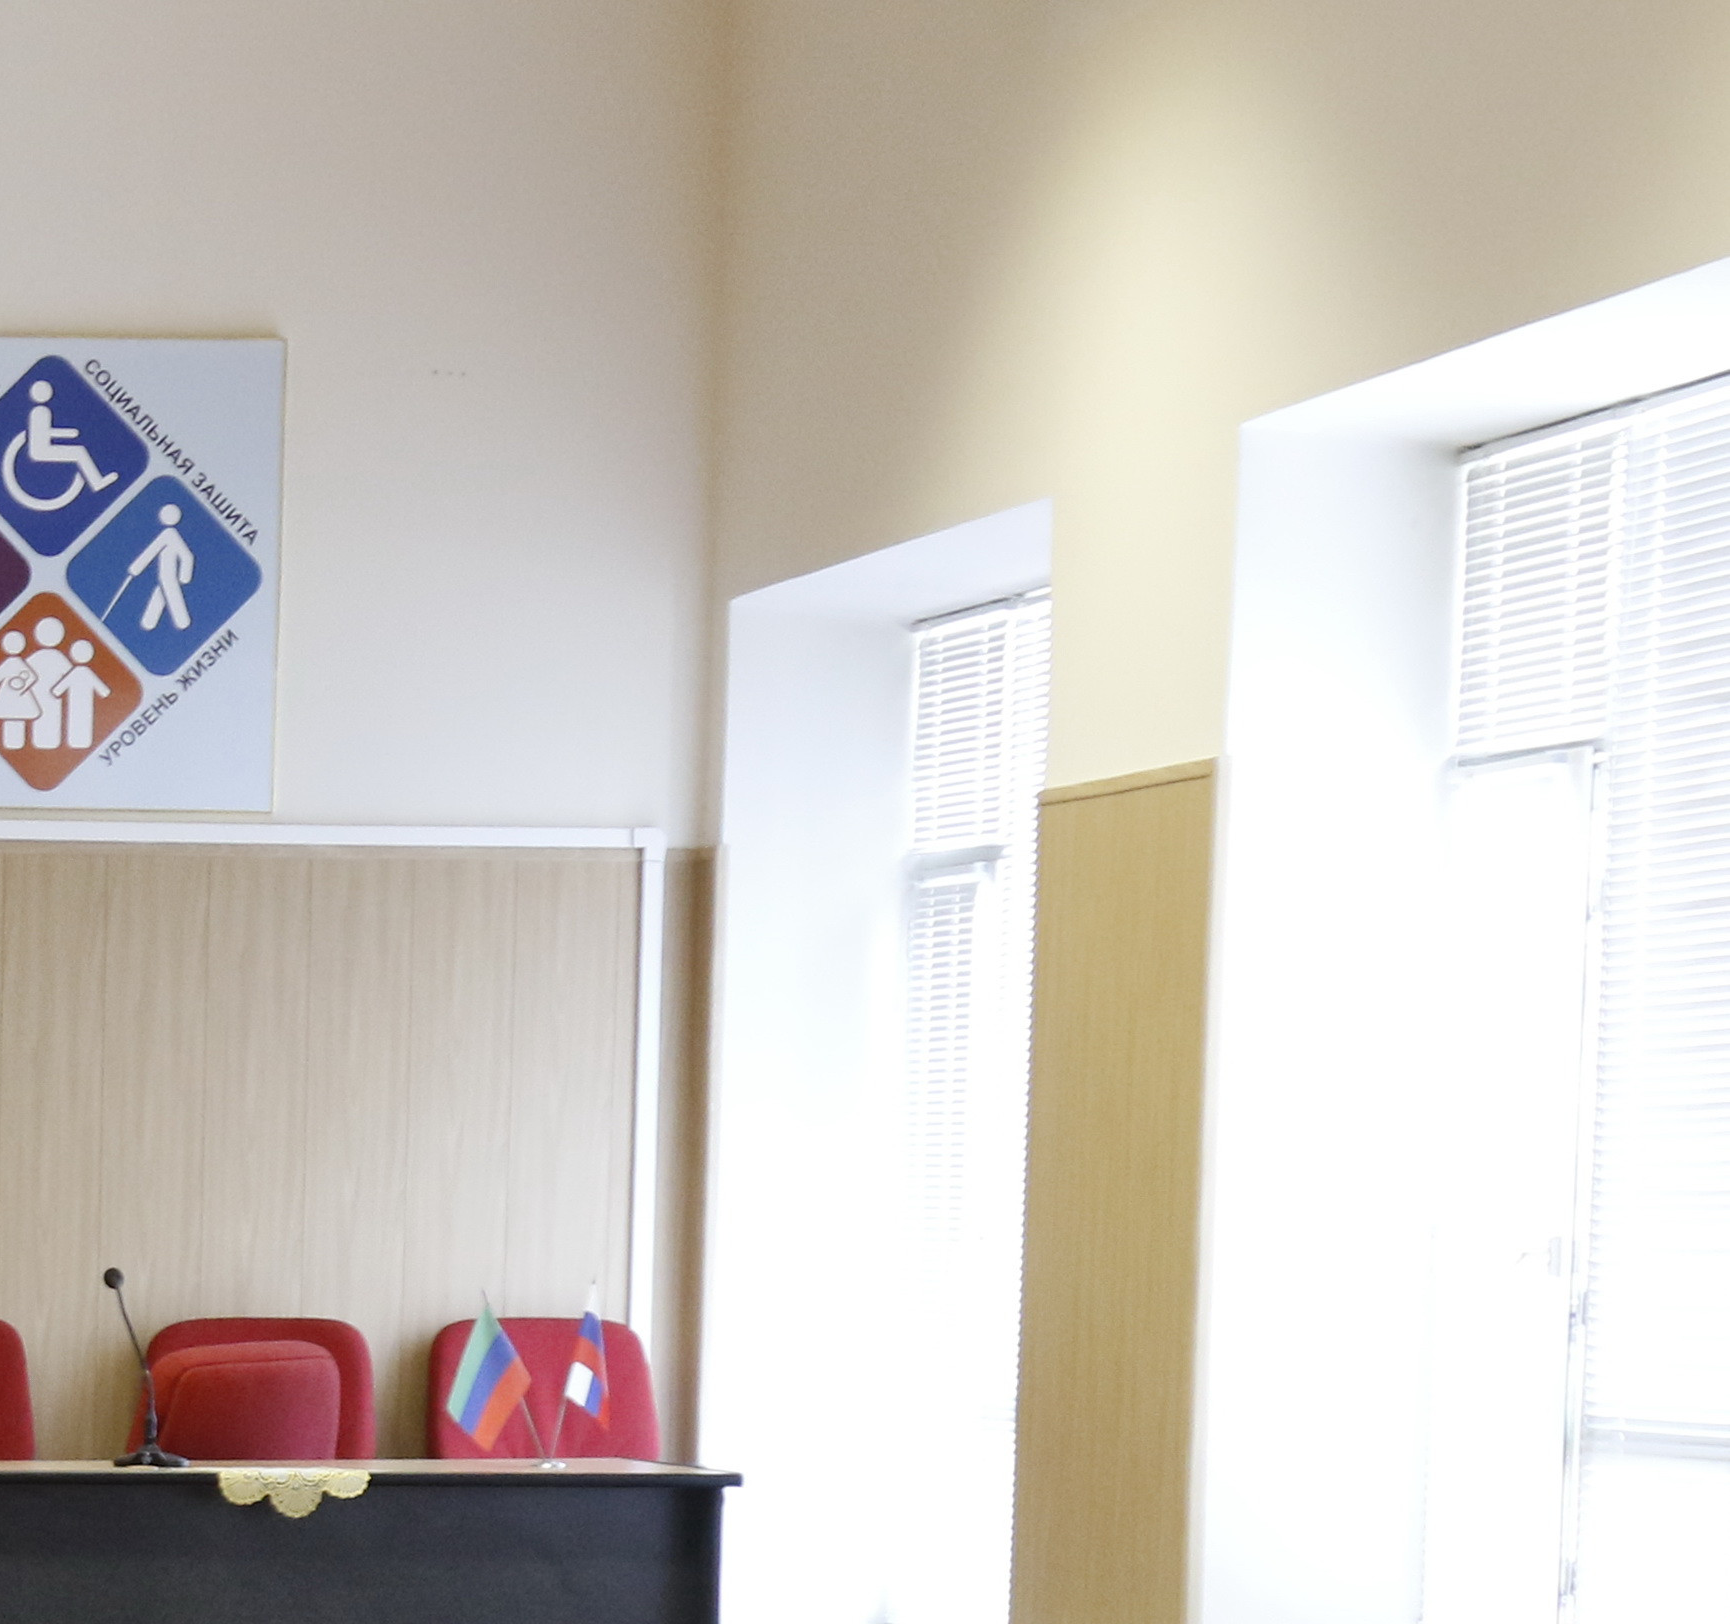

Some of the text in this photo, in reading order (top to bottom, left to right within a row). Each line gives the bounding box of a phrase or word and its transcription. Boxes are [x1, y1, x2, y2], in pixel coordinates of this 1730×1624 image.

[83, 358, 195, 476] СОЦИАЛЬНАЯ
[98, 628, 240, 767] УРОВЕНЬ ЖИЗНИ
